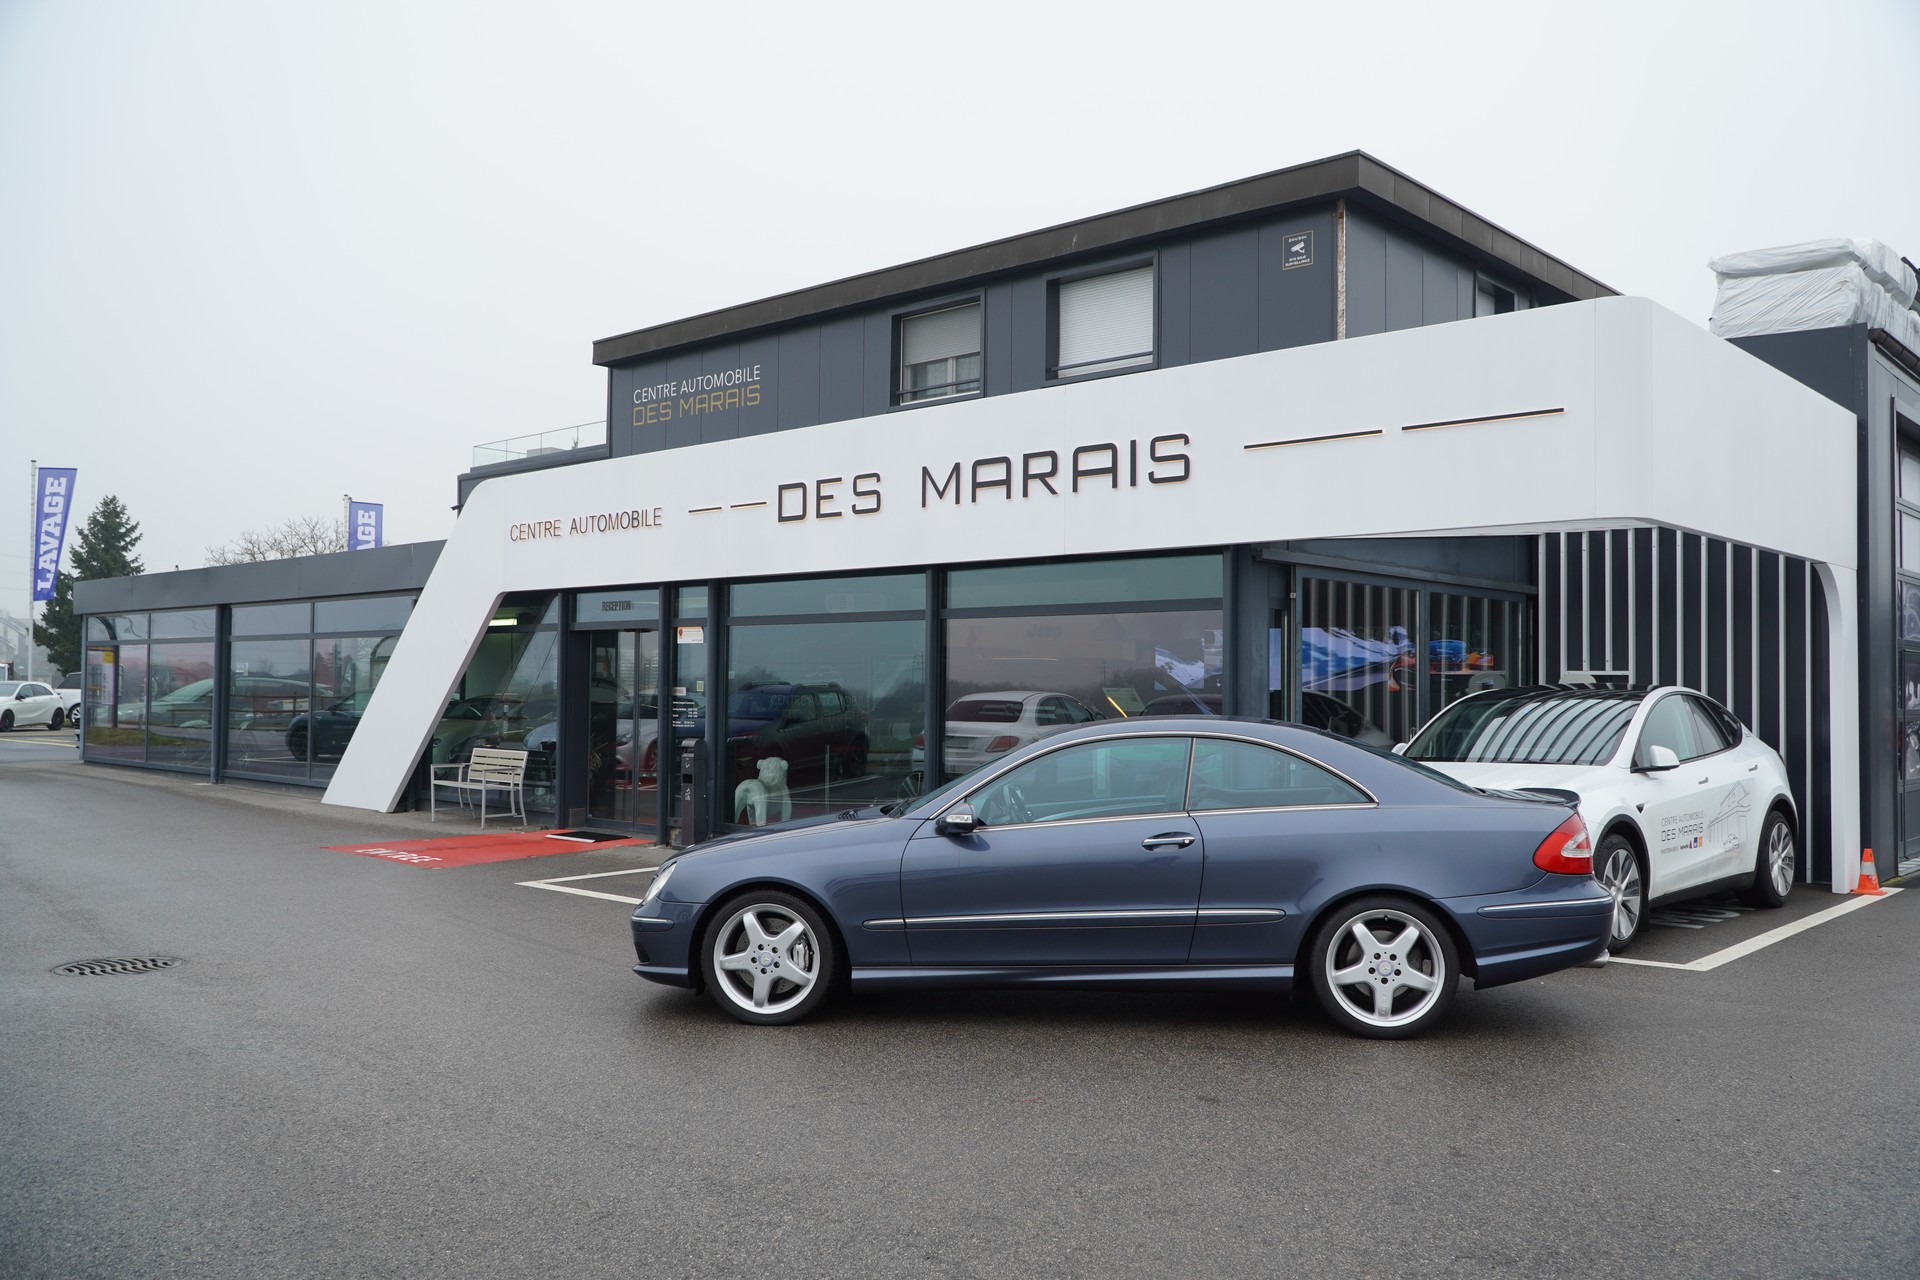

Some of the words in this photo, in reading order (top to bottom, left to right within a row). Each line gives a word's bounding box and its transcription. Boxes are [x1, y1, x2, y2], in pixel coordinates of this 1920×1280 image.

[633, 382, 677, 404] CENTRE
[680, 364, 760, 395] AUTOMOBILE
[633, 401, 672, 427] DES
[679, 384, 760, 418] MARAIS
[510, 519, 561, 542] CENTRE
[569, 507, 662, 536] AUTOMOBILE
[777, 472, 882, 523] DES
[921, 434, 1190, 508] MARAIS
[37, 477, 67, 591] LAVAGE
[770, 694, 806, 707] CENTRE
[1661, 828, 1677, 842] DES
[1678, 822, 1704, 839] MARAIS
